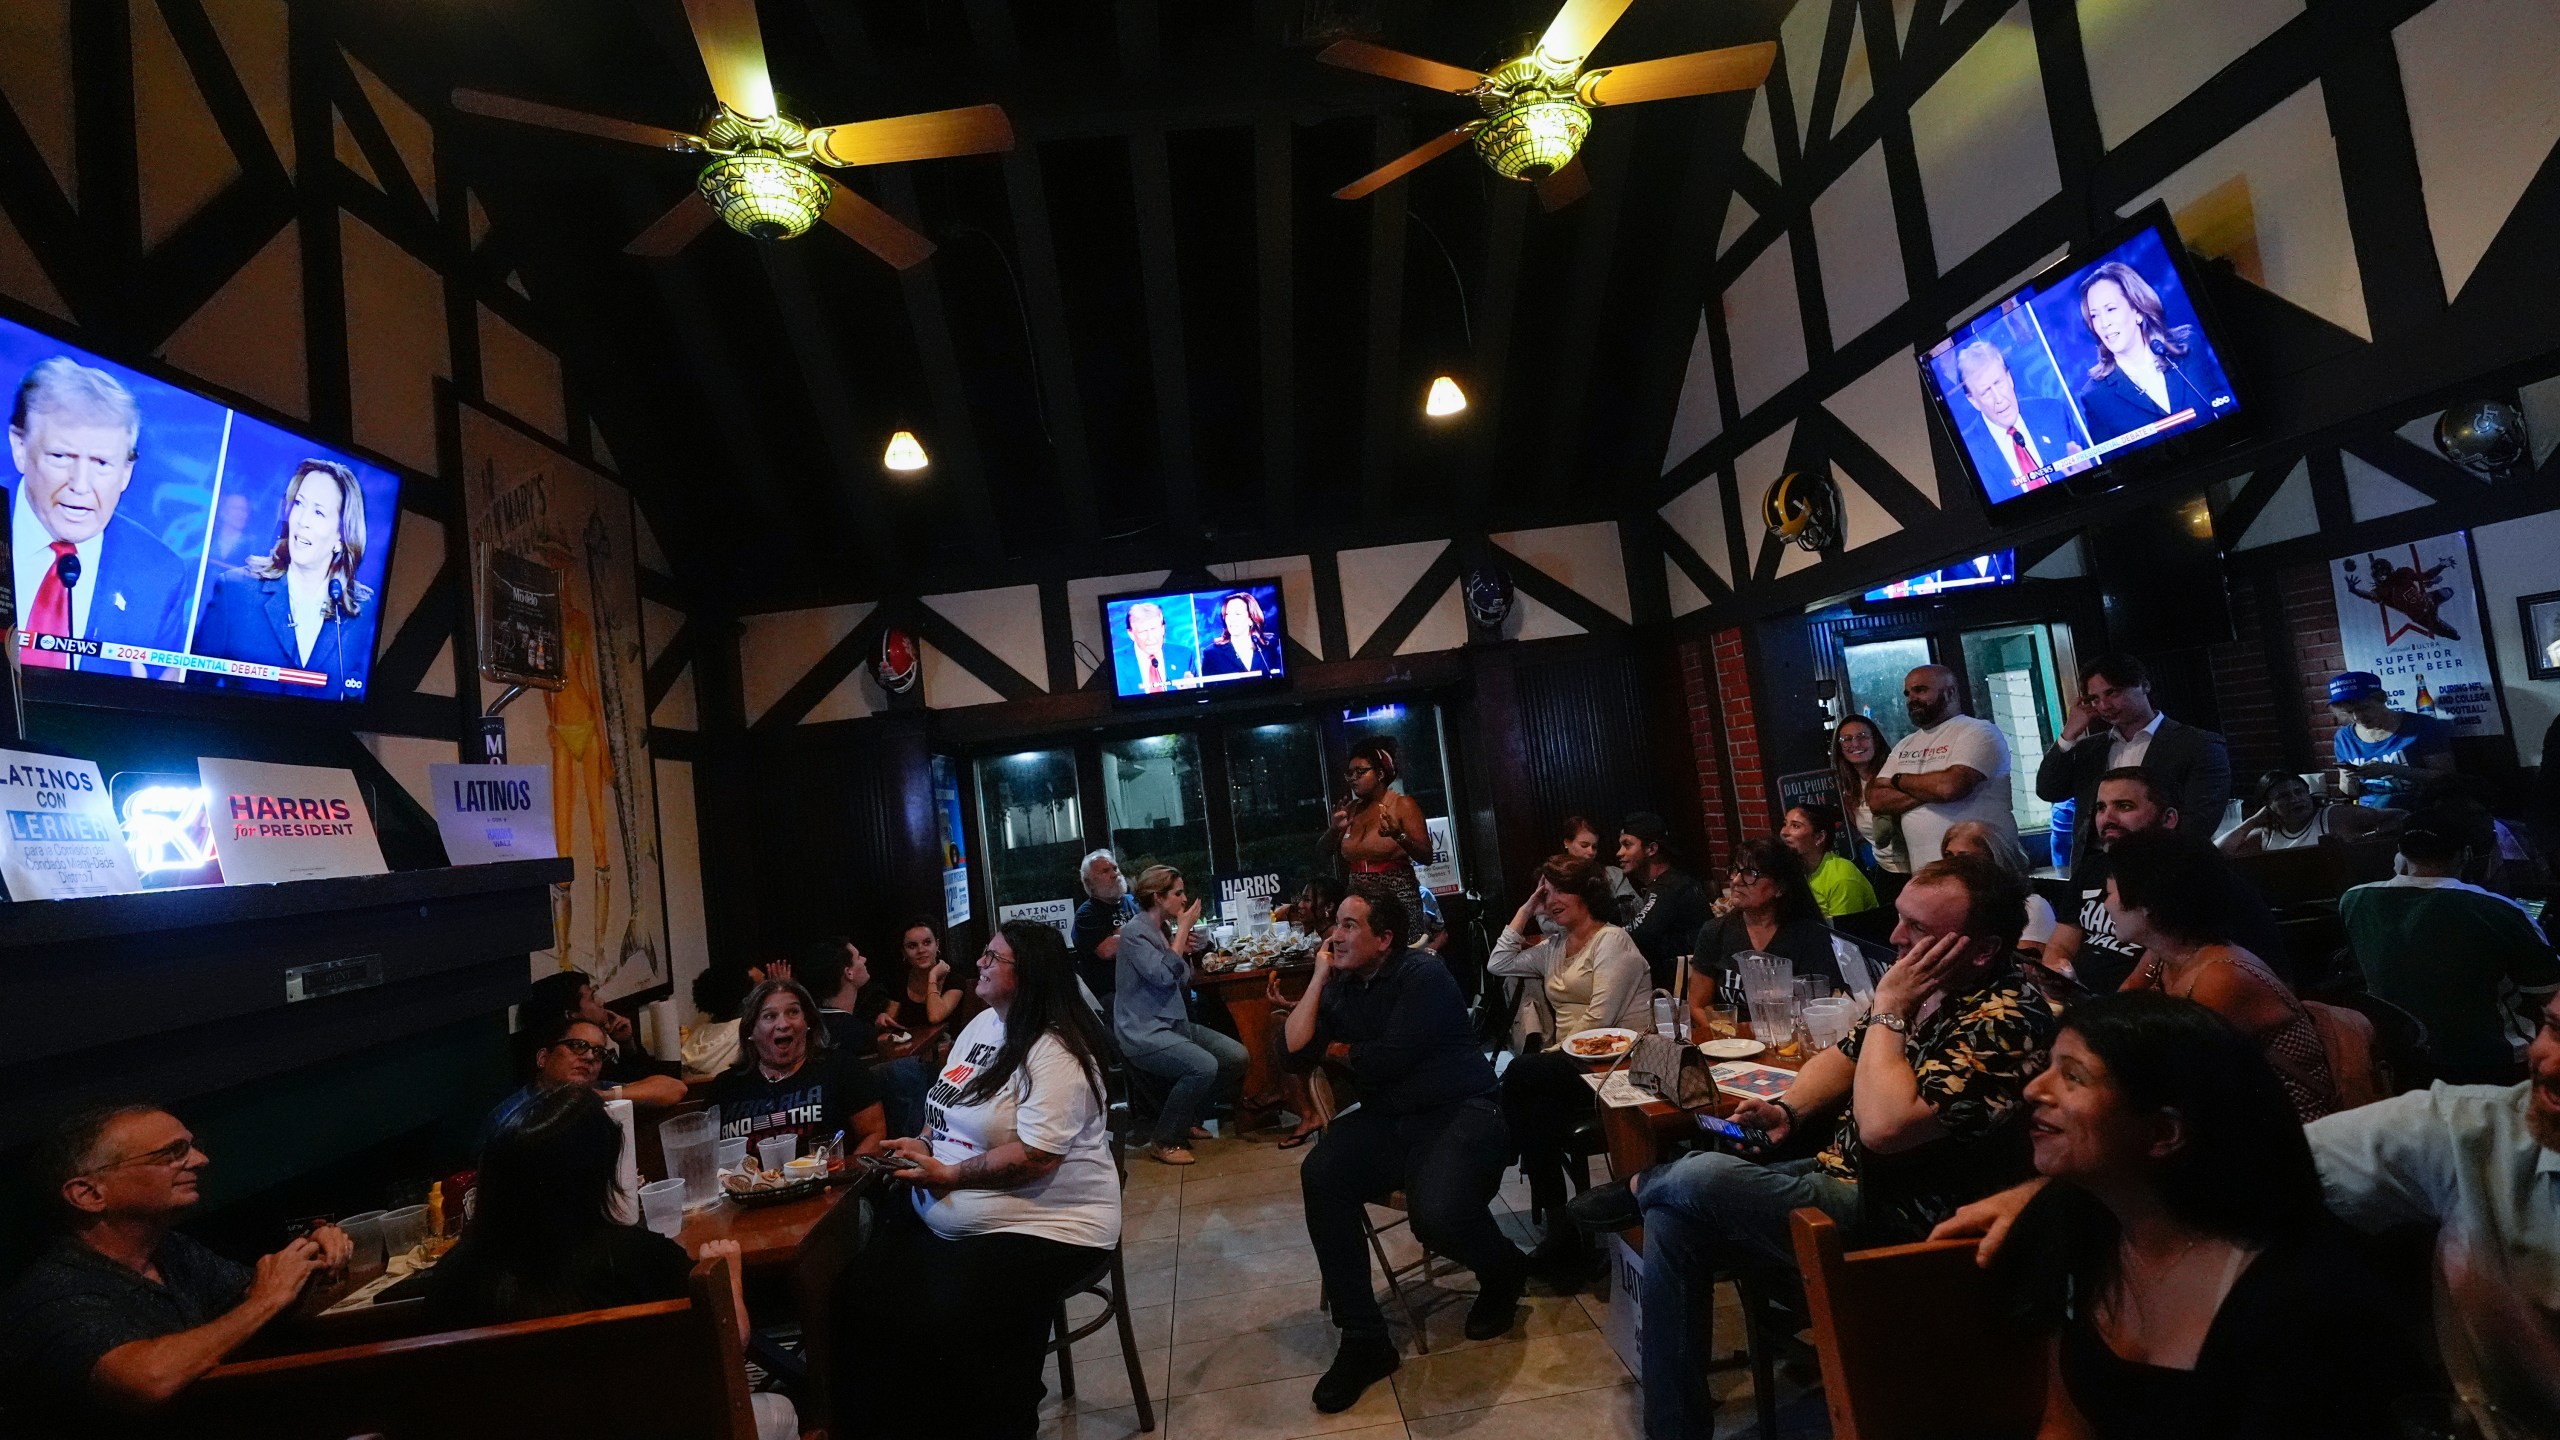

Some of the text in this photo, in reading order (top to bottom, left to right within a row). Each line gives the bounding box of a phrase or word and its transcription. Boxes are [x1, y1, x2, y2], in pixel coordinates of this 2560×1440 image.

[2211, 396, 2230, 408] abc
[2034, 465, 2053, 478] NEWS
[2076, 439, 2120, 460] PRESIDENTIAL
[2120, 428, 2149, 445] DEBATE
[55, 638, 98, 655] NEWS
[117, 647, 147, 660] 2024
[150, 652, 227, 672] PRESIDENTIAL
[230, 663, 269, 677] DEBATE
[2376, 649, 2452, 666] SUPERIOR
[2427, 659, 2463, 671] BEER
[345, 678, 363, 689] abc
[2439, 683, 2468, 694] DURING
[2455, 693, 2491, 703] COLLEGE
[2445, 704, 2487, 715] FOOTBALL
[1784, 777, 1835, 797] DOLPHINS
[37, 791, 66, 808] CON
[454, 780, 531, 812] LATINOS
[1799, 793, 1827, 805] FAN
[229, 796, 351, 821] HARRIS
[10, 813, 107, 839] LERNER
[234, 824, 353, 840] for PRESIDENT
[24, 844, 44, 856] para
[93, 842, 105, 855] del
[26, 857, 115, 870] Condado Miami-Dade
[58, 870, 88, 884] Distrito
[1221, 873, 1281, 900] HARRIS
[1010, 904, 1066, 918] LATINOS
[721, 1118, 752, 1140] AND
[788, 1104, 822, 1125] THE
